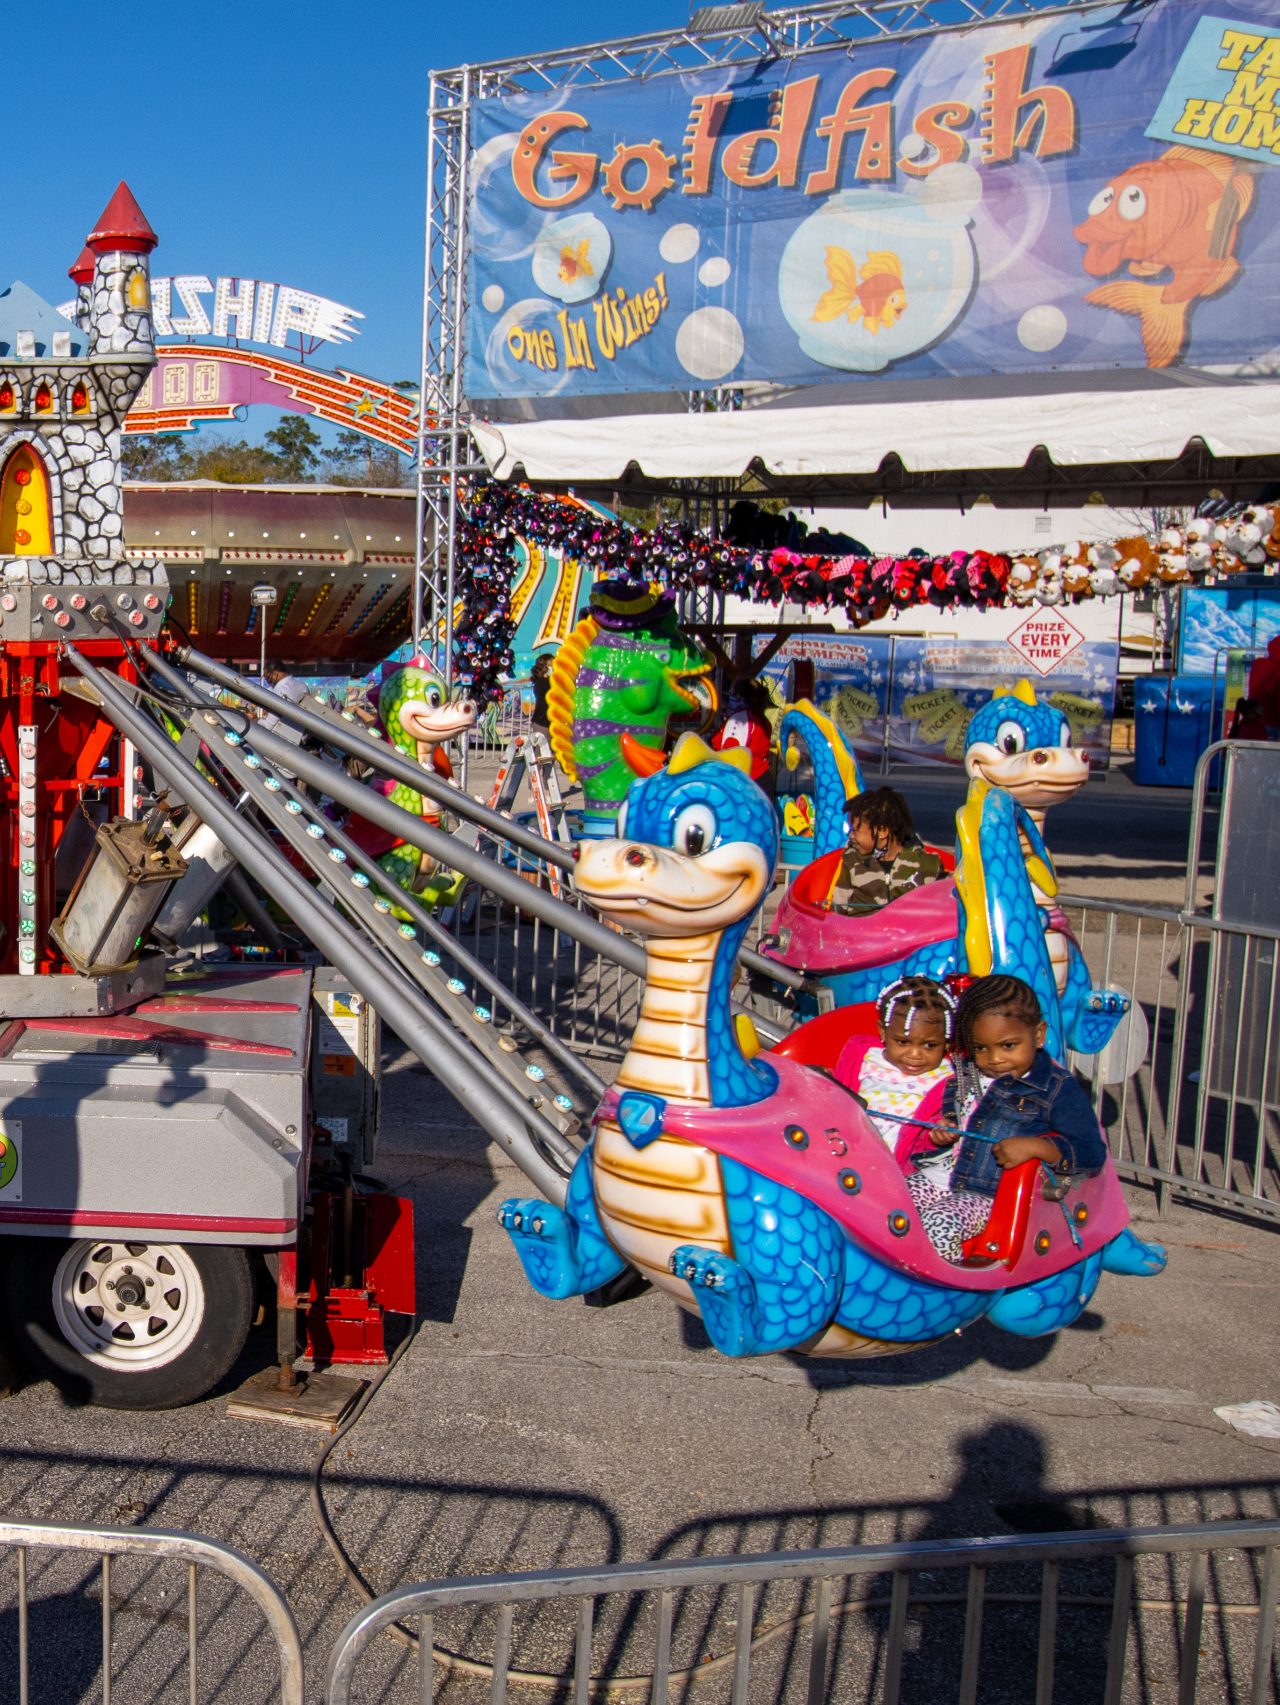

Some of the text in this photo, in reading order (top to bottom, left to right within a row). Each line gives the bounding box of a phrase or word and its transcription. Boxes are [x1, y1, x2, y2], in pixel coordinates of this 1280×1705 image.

[511, 43, 1076, 211] Goldfish
[557, 308, 597, 372] In
[592, 271, 670, 360] Wins!
[1026, 622, 1065, 632] PRIZE
[1021, 633, 1071, 646] EVERY
[1028, 649, 1061, 658] TIME
[847, 692, 873, 713] TICKET
[911, 695, 947, 713] TICKET
[1060, 699, 1096, 718] TICKET
[926, 707, 957, 735] TICKET
[824, 1127, 848, 1157] 5
